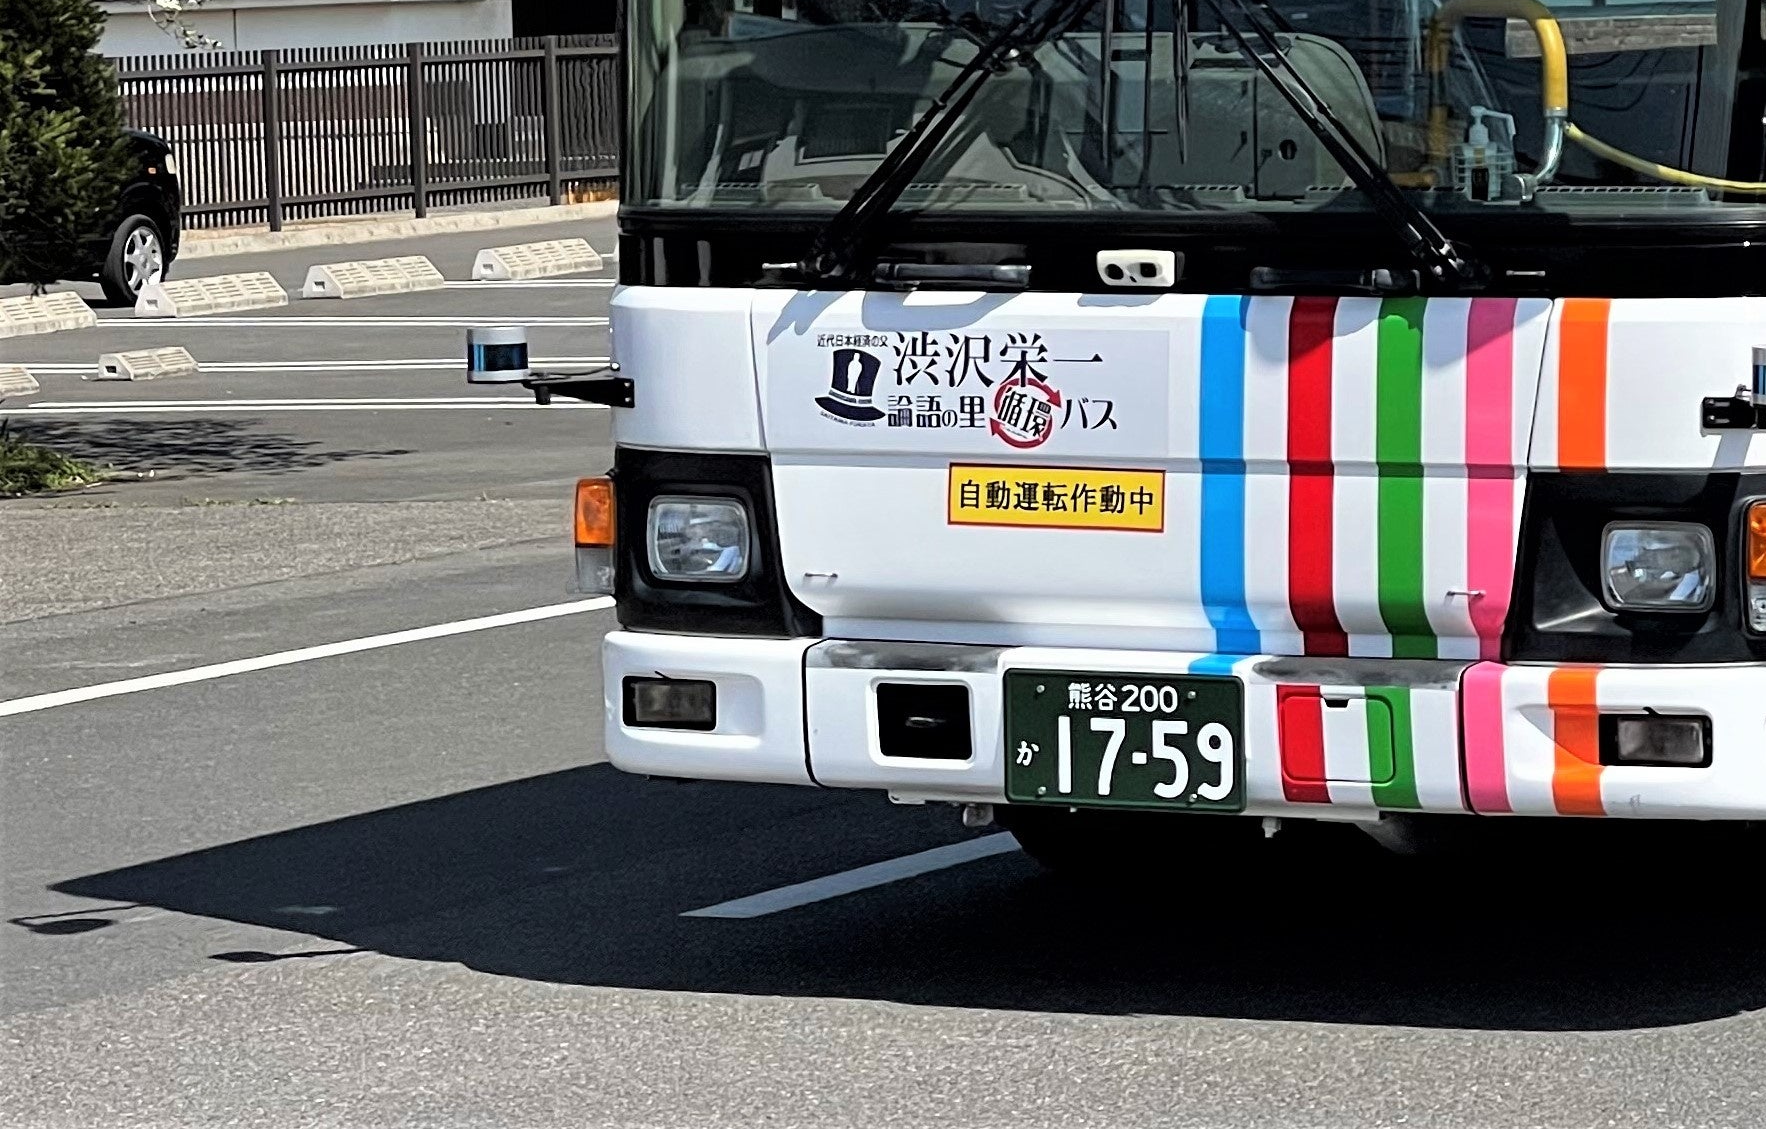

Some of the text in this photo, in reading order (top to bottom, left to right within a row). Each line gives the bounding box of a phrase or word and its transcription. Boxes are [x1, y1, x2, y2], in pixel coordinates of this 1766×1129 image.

[817, 333, 888, 347] 近代日本経済の父
[892, 331, 1103, 389] 渋沢栄一
[957, 480, 1154, 516] 自動運転作動中
[1015, 714, 1235, 802] か 17-59
